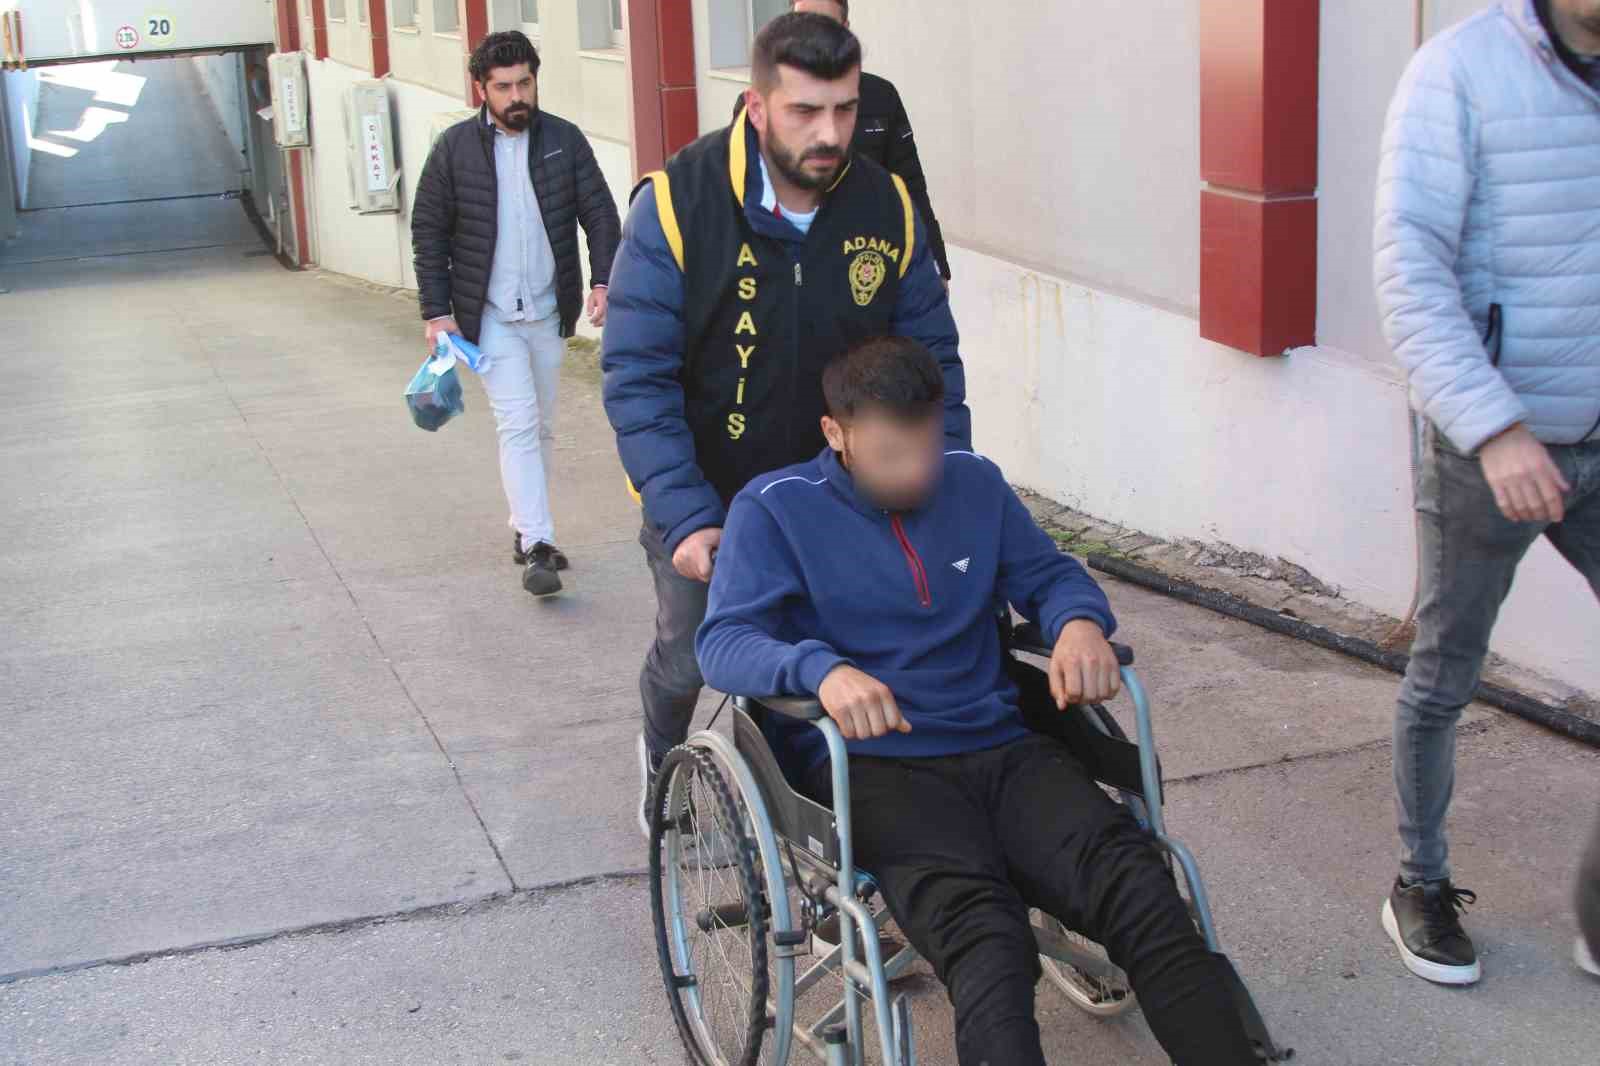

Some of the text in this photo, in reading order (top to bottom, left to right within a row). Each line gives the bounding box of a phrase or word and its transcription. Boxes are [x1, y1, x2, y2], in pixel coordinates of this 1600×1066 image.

[149, 19, 170, 36] 20
[843, 236, 899, 262] ADANA
[727, 243, 758, 439] ASAYİŞ
